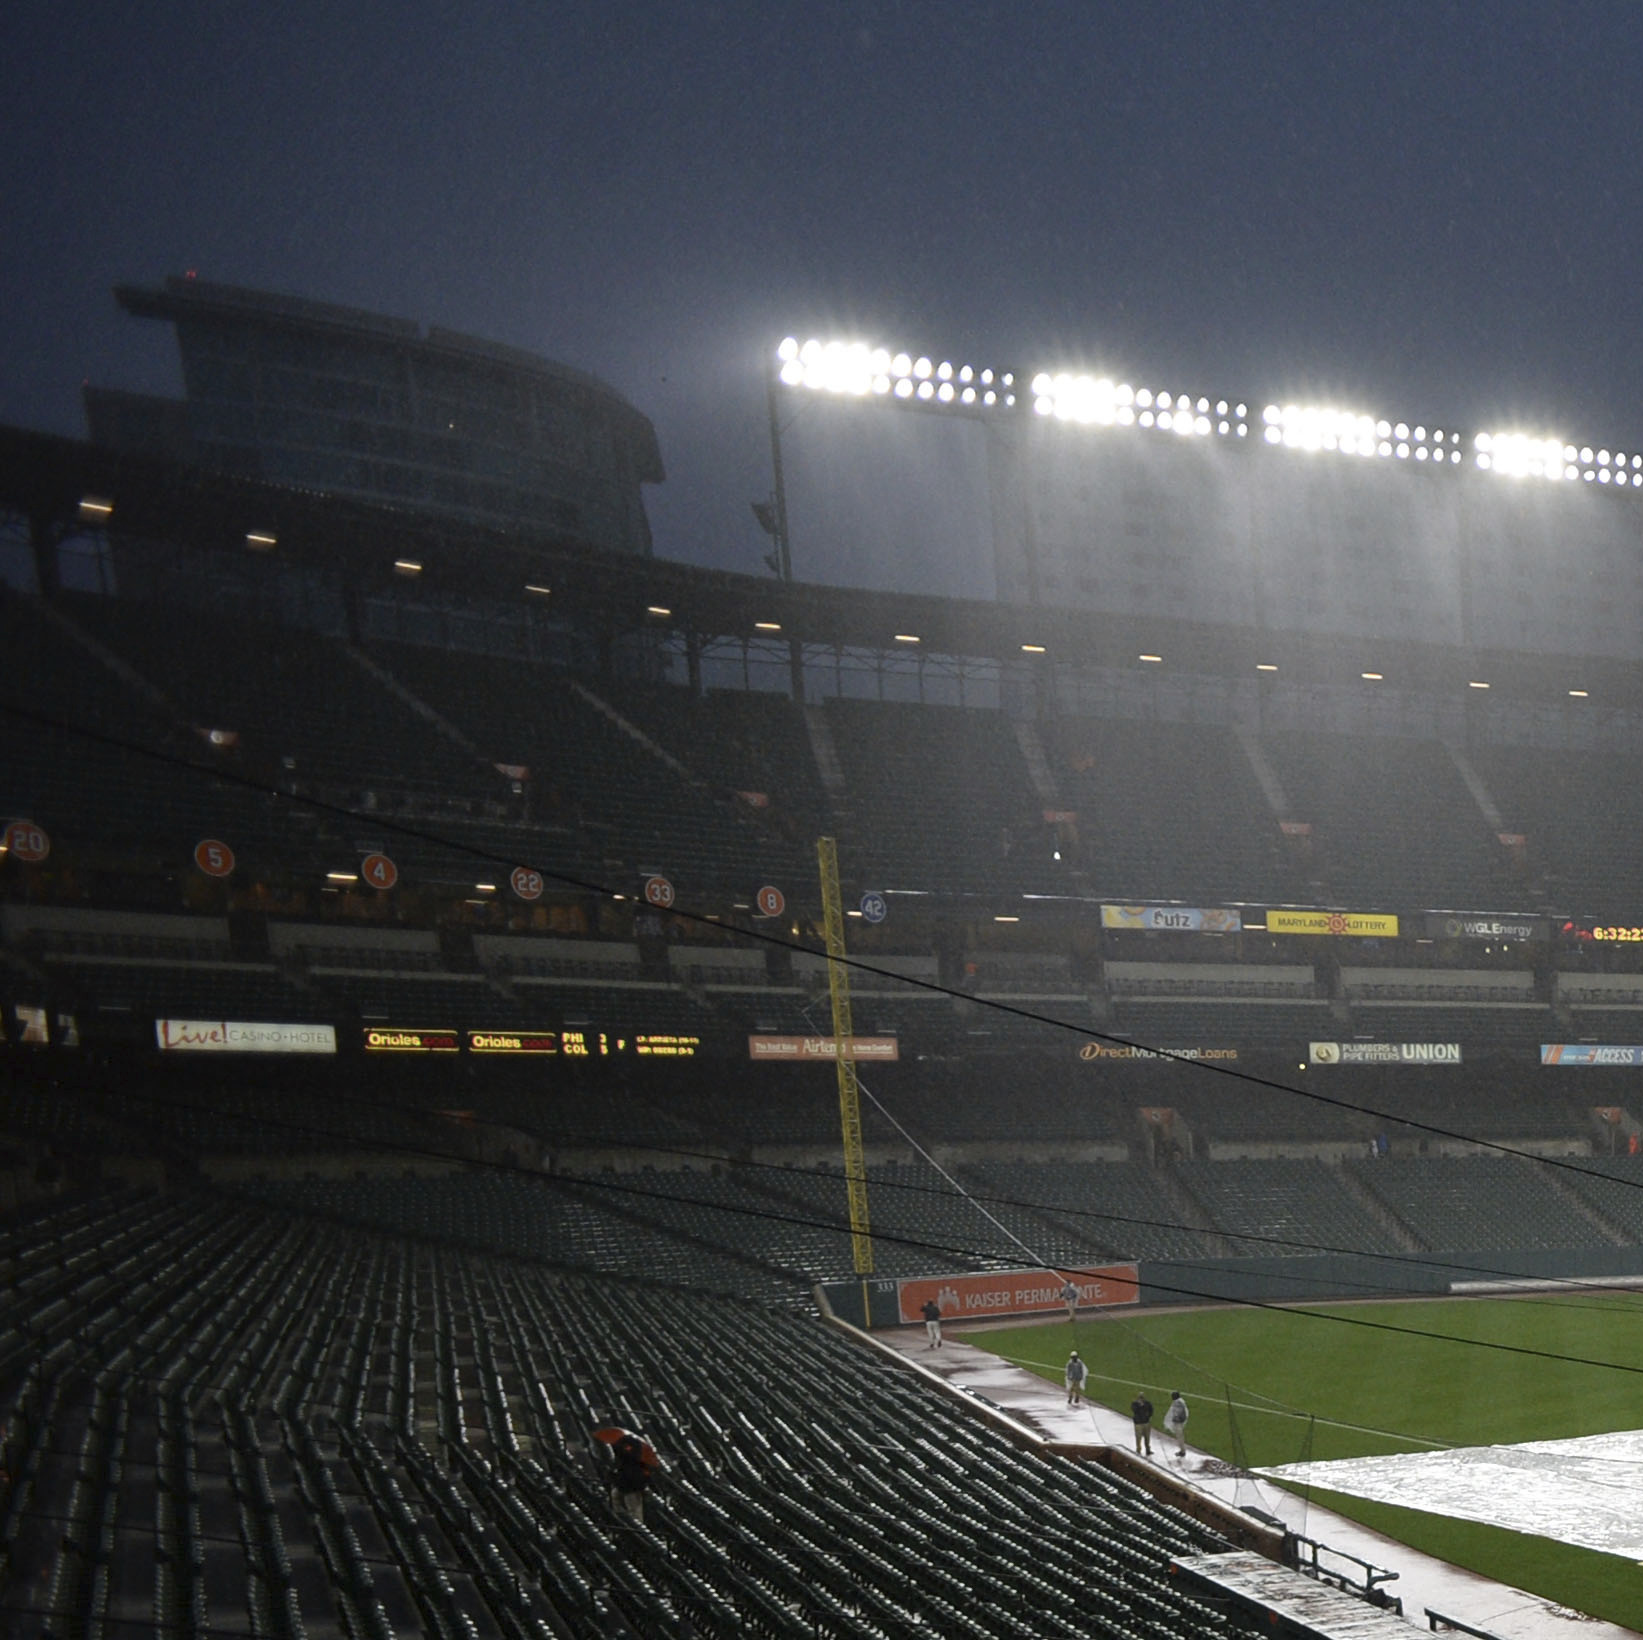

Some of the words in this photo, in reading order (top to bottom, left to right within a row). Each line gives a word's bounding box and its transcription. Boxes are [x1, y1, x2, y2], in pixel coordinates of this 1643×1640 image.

[12, 829, 45, 851] 20
[208, 848, 223, 868] 5
[372, 861, 385, 880] 4
[516, 873, 540, 892] 22
[650, 878, 671, 898] 33
[766, 894, 777, 909] 8
[864, 897, 883, 915] 42
[1277, 918, 1328, 929] MARYLAND
[1348, 920, 1387, 931] LOTTERY
[562, 1033, 584, 1043] PHI
[563, 1045, 589, 1055] COL
[1342, 1043, 1389, 1053] PLUMBERS
[1342, 1052, 1363, 1061] PIPE
[1364, 1052, 1399, 1062] FITTERS
[1402, 1043, 1460, 1061] UNION
[1594, 1048, 1635, 1063] ACCESS
[965, 1291, 1011, 1309] KAISER
